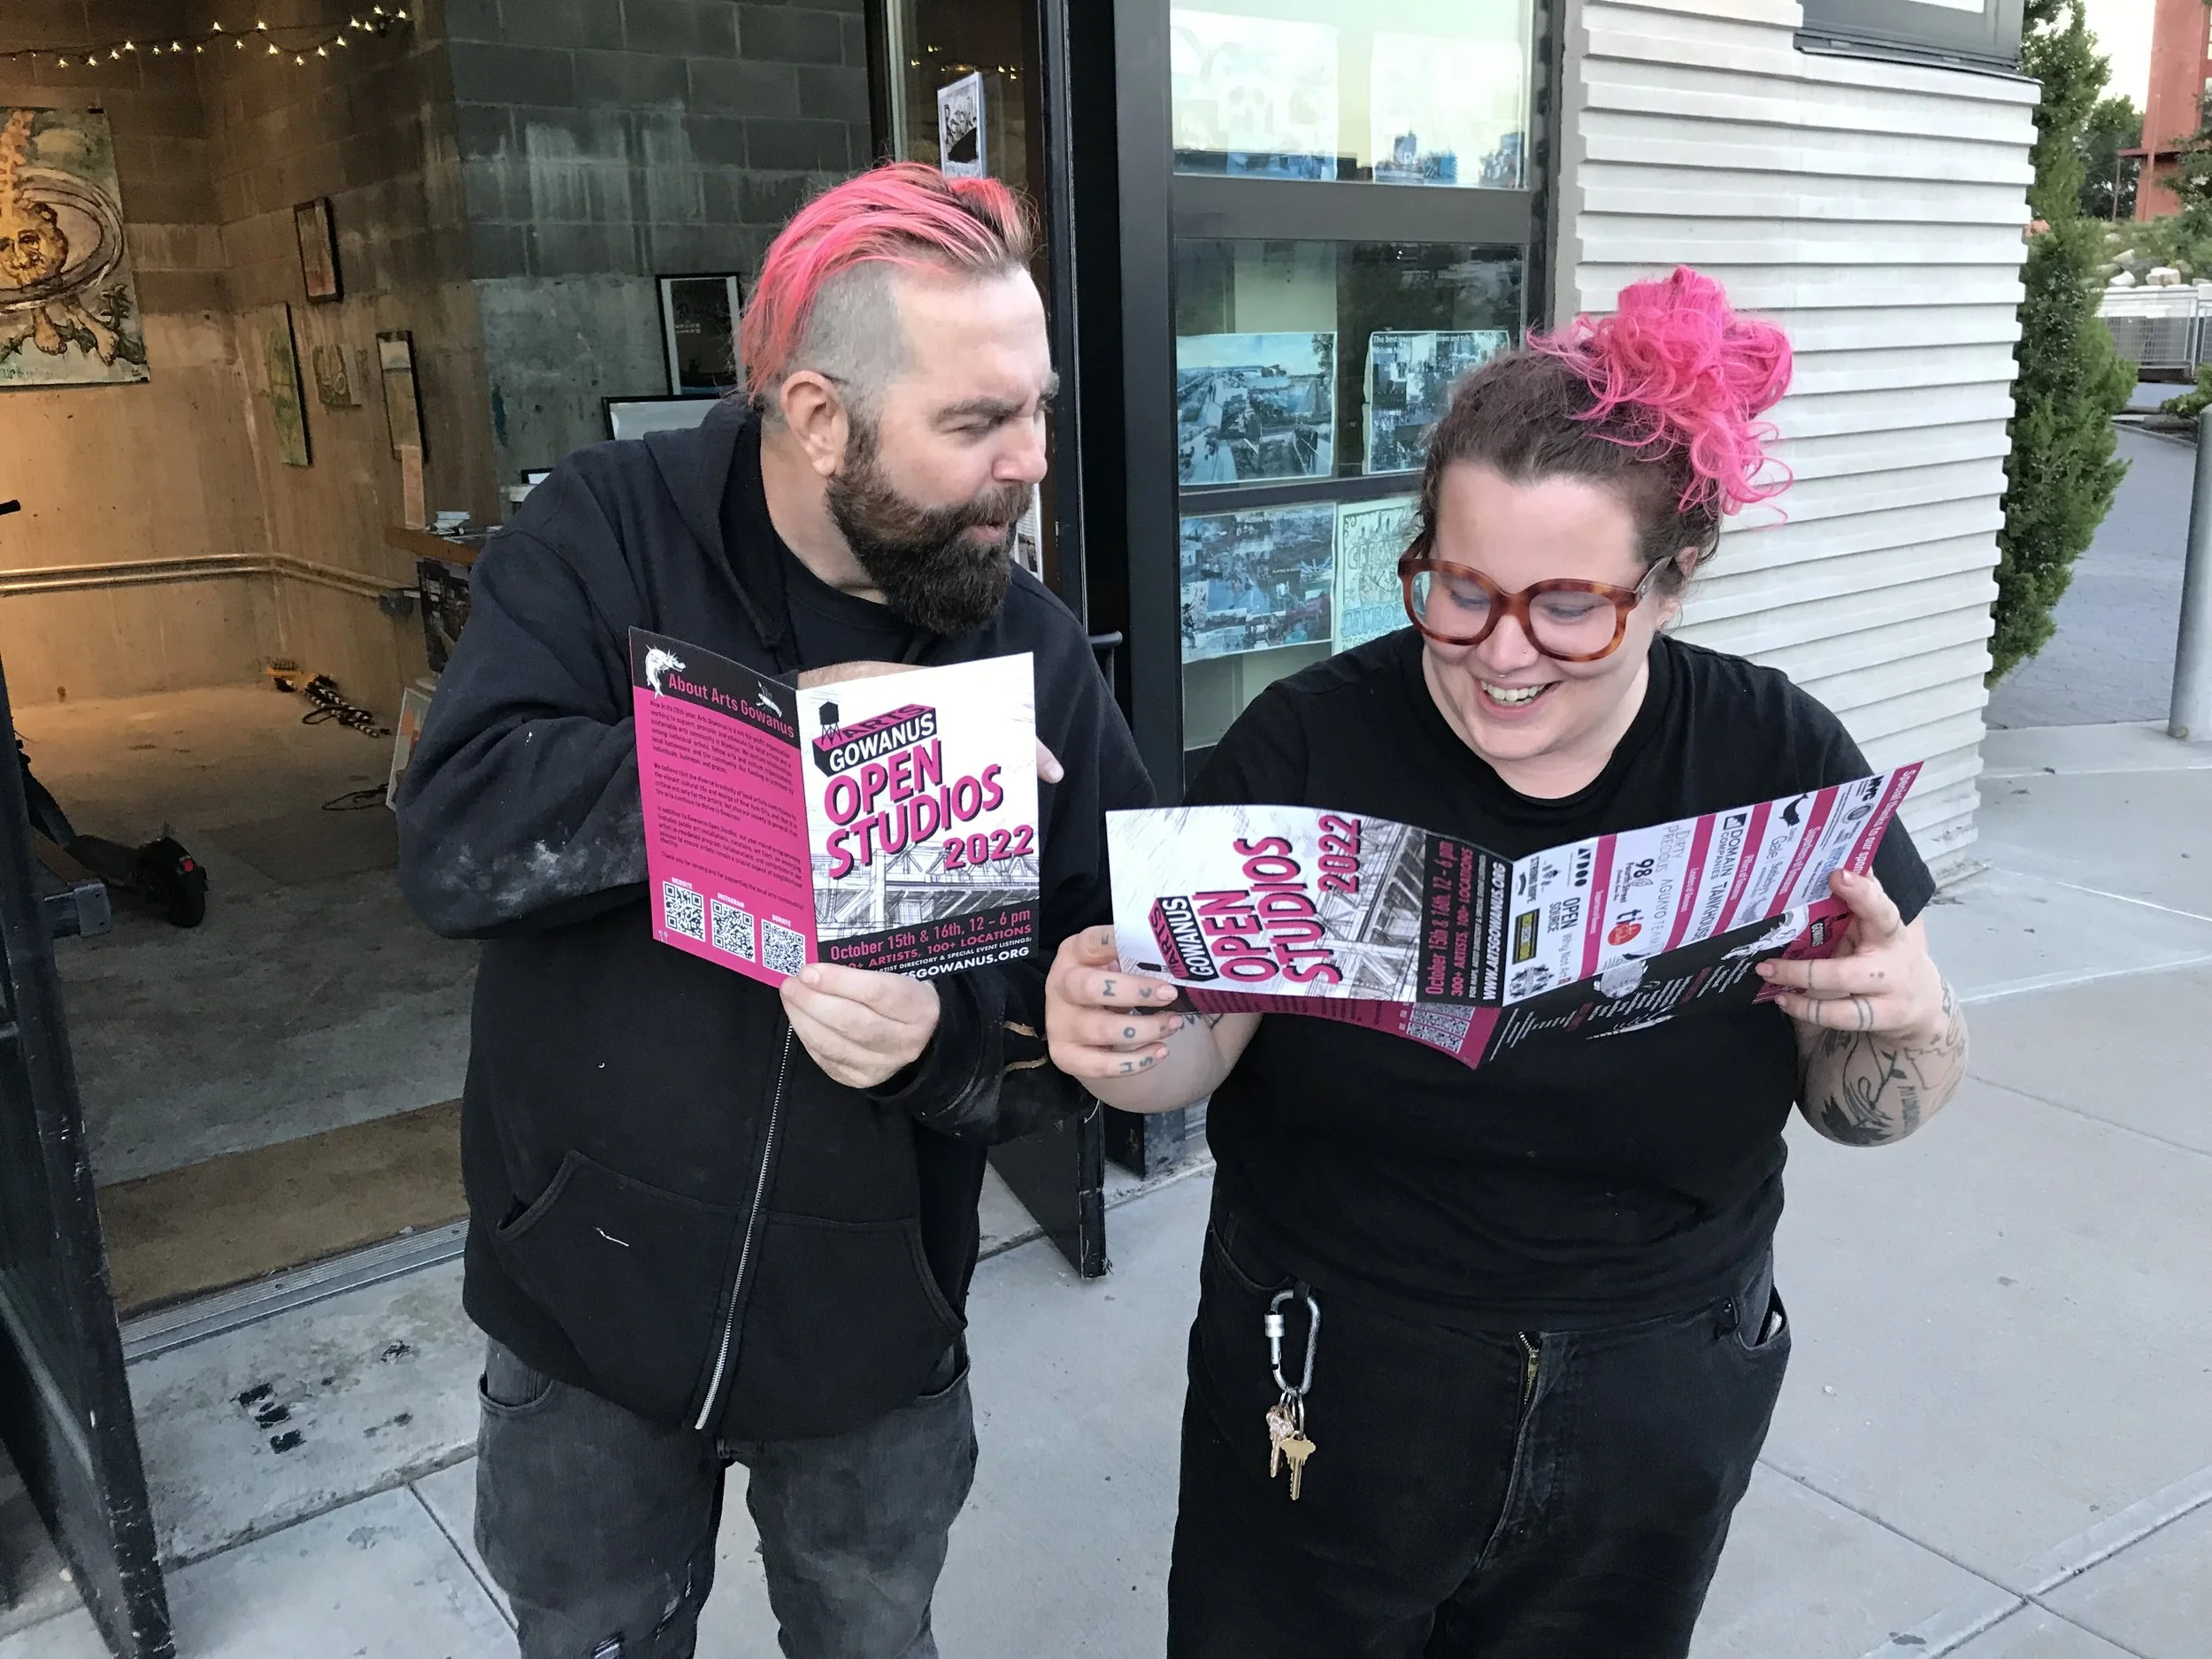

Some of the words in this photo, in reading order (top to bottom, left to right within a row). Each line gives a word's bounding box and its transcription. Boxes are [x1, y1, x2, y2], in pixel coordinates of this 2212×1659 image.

[669, 672, 708, 700] About
[711, 687, 738, 711] Arts
[741, 699, 795, 739] Gowanus
[842, 705, 926, 739] ARTS
[829, 713, 935, 772] GOWANUS
[824, 738, 942, 826] OPEN
[1863, 775, 1884, 802] NYC
[826, 764, 1004, 880] STUDIOS
[942, 825, 1034, 871] 2022
[1317, 815, 1362, 894] 2022
[1633, 858, 1655, 878] 98
[1709, 832, 1728, 879] COMPANIES
[1720, 829, 1743, 878] DOMAIN
[1766, 835, 1787, 859] Gale
[1853, 851, 1869, 874] spon
[772, 914, 792, 927] DONATE
[1233, 836, 1343, 984] STUDIOS
[1483, 861, 1505, 1000] WWW.ARTSGOWANUS.ORG
[1548, 901, 1562, 933] SOURCE
[1561, 896, 1580, 931] OPEN
[1692, 881, 1727, 941] TANKHOUSE
[830, 941, 884, 961] October
[887, 931, 916, 949] 15th
[920, 930, 929, 943] &
[933, 922, 965, 939] 16th,
[969, 916, 984, 932] 12
[999, 911, 1007, 926] 6
[1010, 909, 1031, 926] pm
[868, 949, 921, 968] ARTISTS,
[927, 941, 956, 954] 100+
[960, 924, 1032, 948] LOCATIONS
[899, 956, 939, 970] DIRECTORY
[947, 948, 975, 959] SPECIAL
[976, 943, 998, 954] EVENT
[1149, 905, 1180, 967] ARTS
[1161, 897, 1215, 977] GOWANUS
[1192, 889, 1279, 982] OPEN
[900, 947, 1030, 979] SGOWANUS.ORG
[1425, 952, 1447, 995] October
[1451, 972, 1463, 996] 300+
